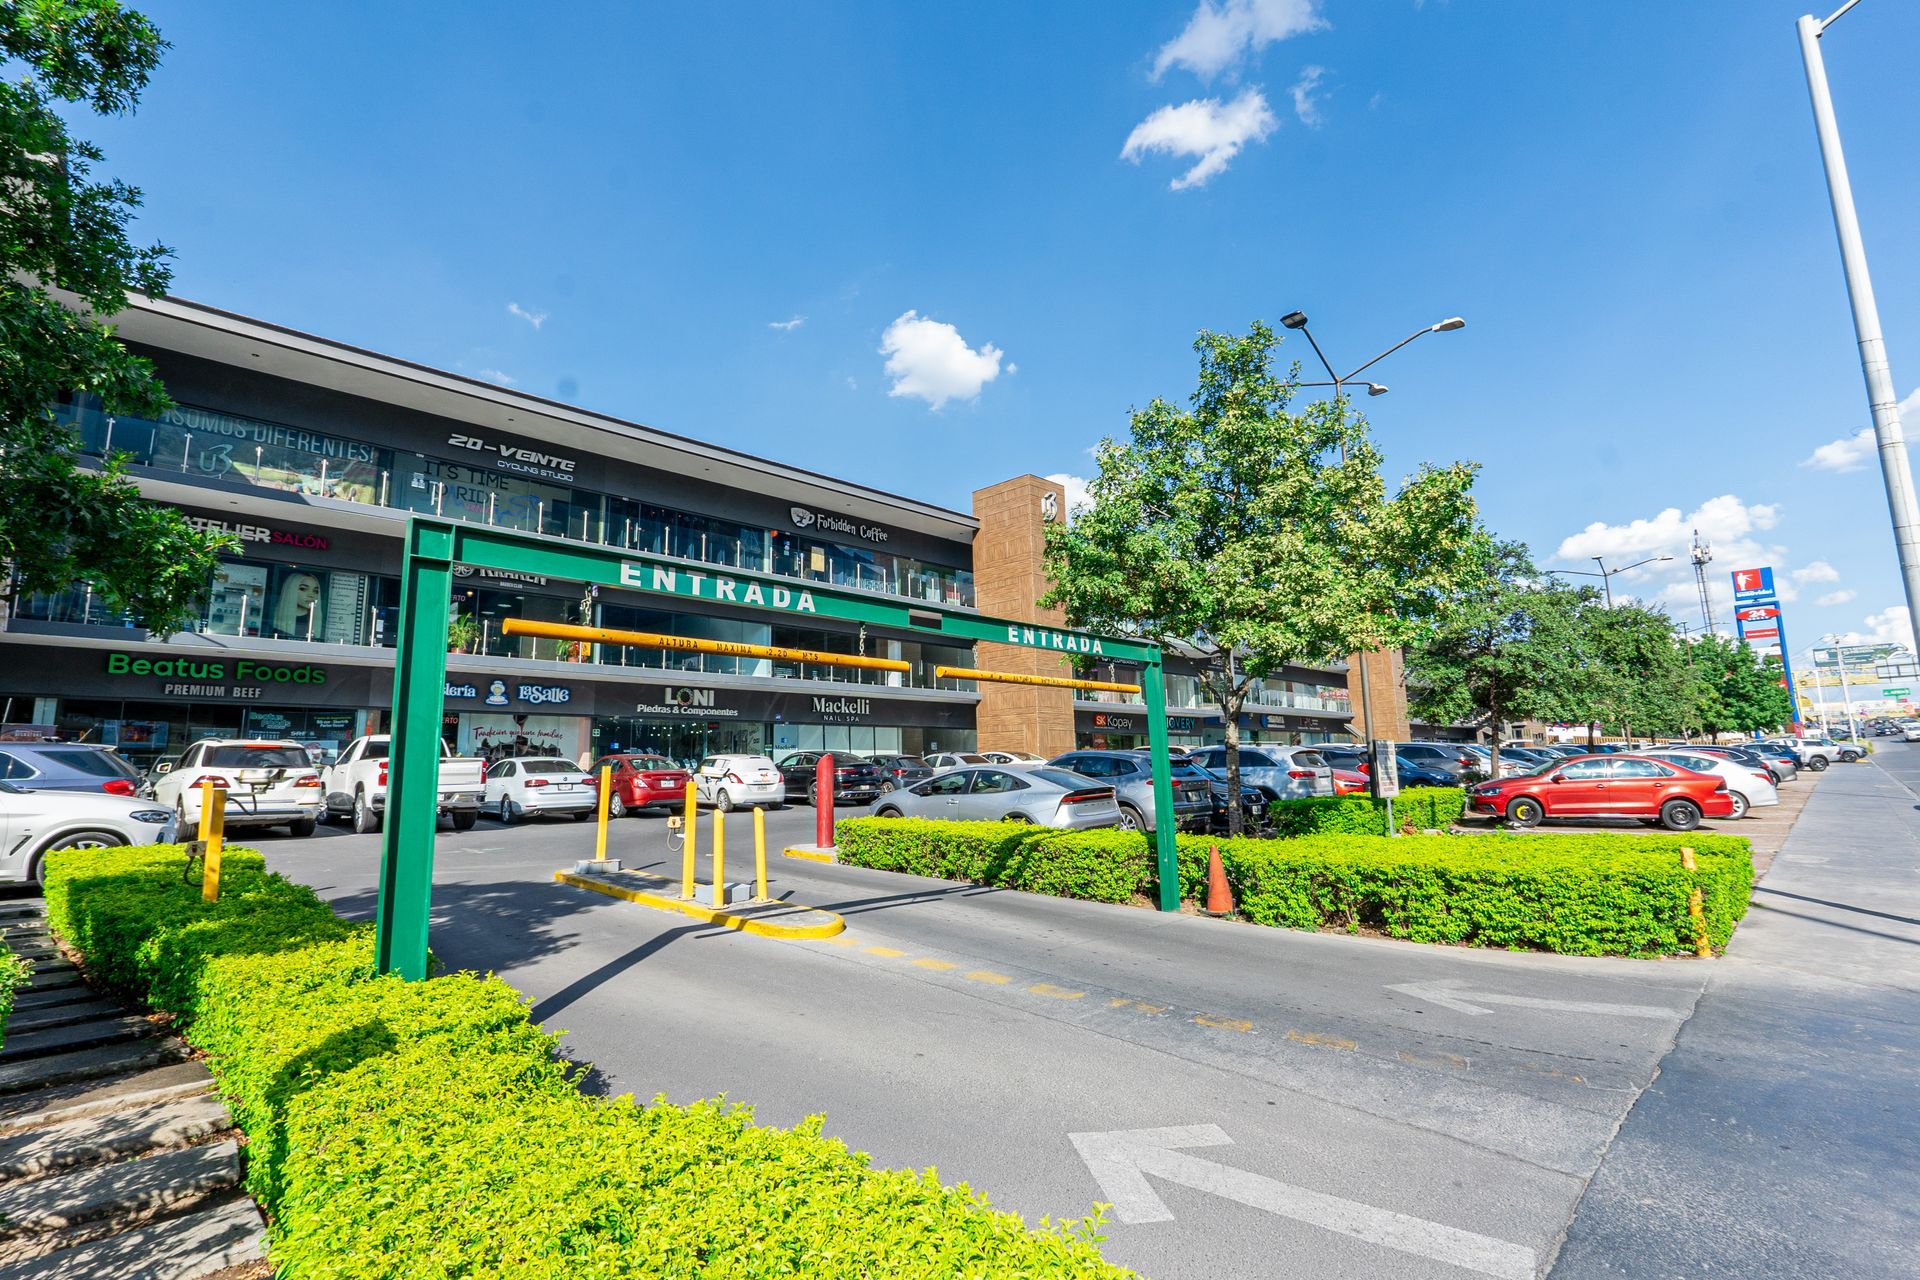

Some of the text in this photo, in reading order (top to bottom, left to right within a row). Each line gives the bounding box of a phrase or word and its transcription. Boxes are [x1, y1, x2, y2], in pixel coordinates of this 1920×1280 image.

[253, 421, 375, 464] DIFERENTES!
[468, 468, 509, 490] TIME
[497, 460, 574, 482] CYCLING STUDIO
[456, 485, 500, 507] RIDE
[816, 513, 888, 543] Forbidden Coffee
[271, 531, 328, 550] SALÓN
[620, 559, 816, 613] ENTRADA
[1749, 609, 1767, 617] 24
[1007, 624, 1103, 655] ENTRADA
[107, 653, 327, 684] Beatus Foods
[164, 684, 262, 699] PREMIUM BEEF
[443, 682, 477, 698] lería
[664, 687, 715, 707] LONI
[637, 704, 738, 717] Piedras & Componentes
[812, 697, 870, 715] Mackelli
[1107, 714, 1133, 730] Kopay
